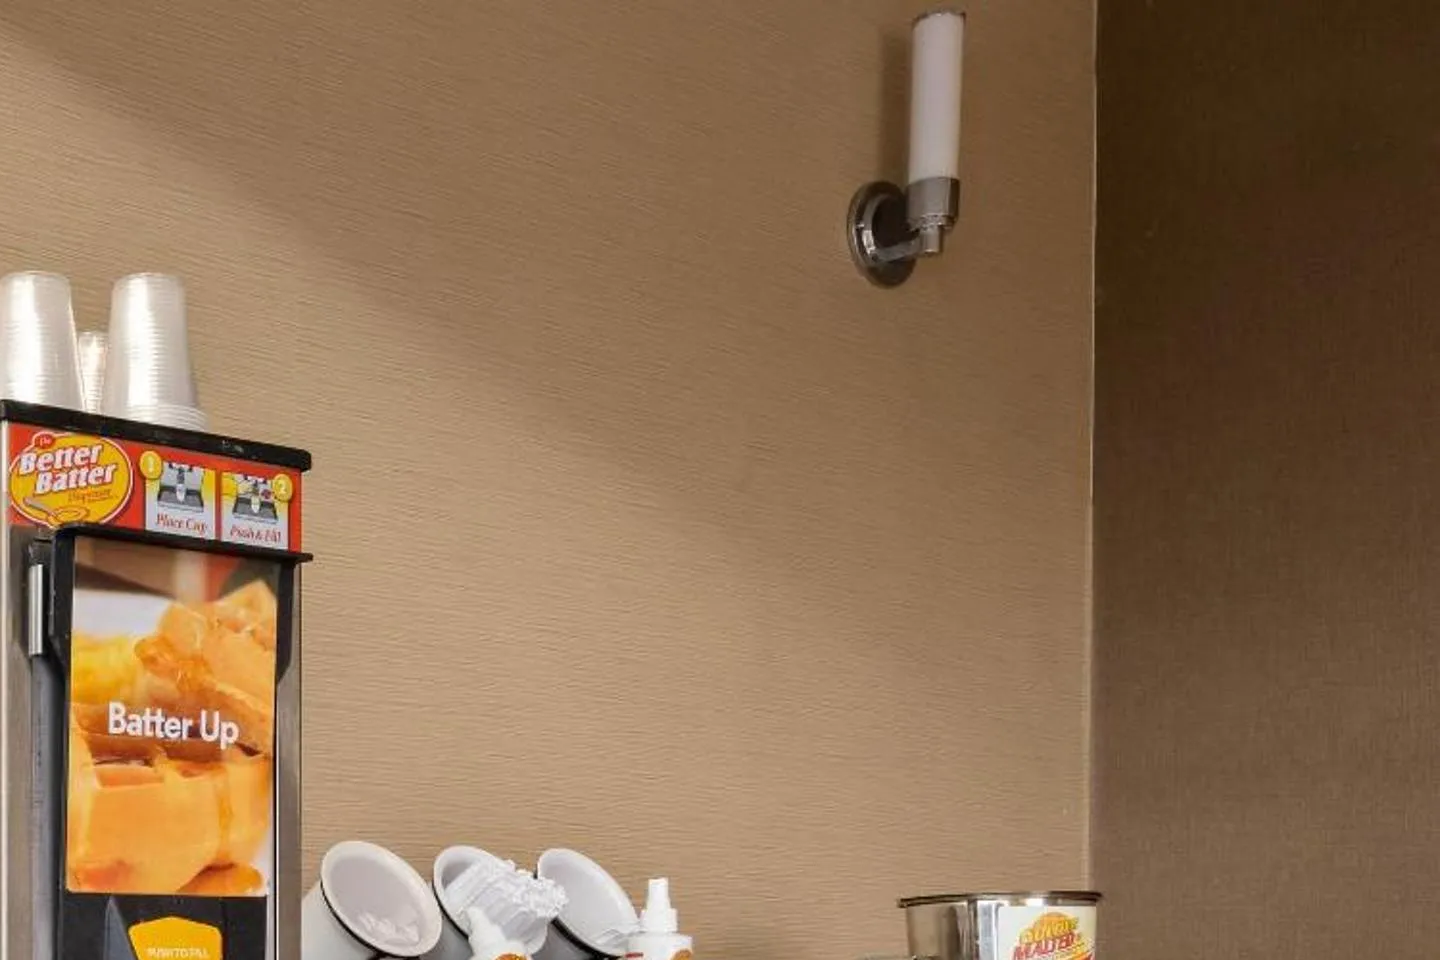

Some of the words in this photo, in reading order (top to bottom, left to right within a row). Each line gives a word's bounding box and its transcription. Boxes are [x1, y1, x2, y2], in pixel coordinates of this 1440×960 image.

[19, 445, 103, 475] Better
[35, 464, 117, 494] Batter
[156, 513, 182, 531] Place
[185, 517, 207, 536] Cup
[108, 701, 193, 740] Batter
[200, 709, 240, 750] Up
